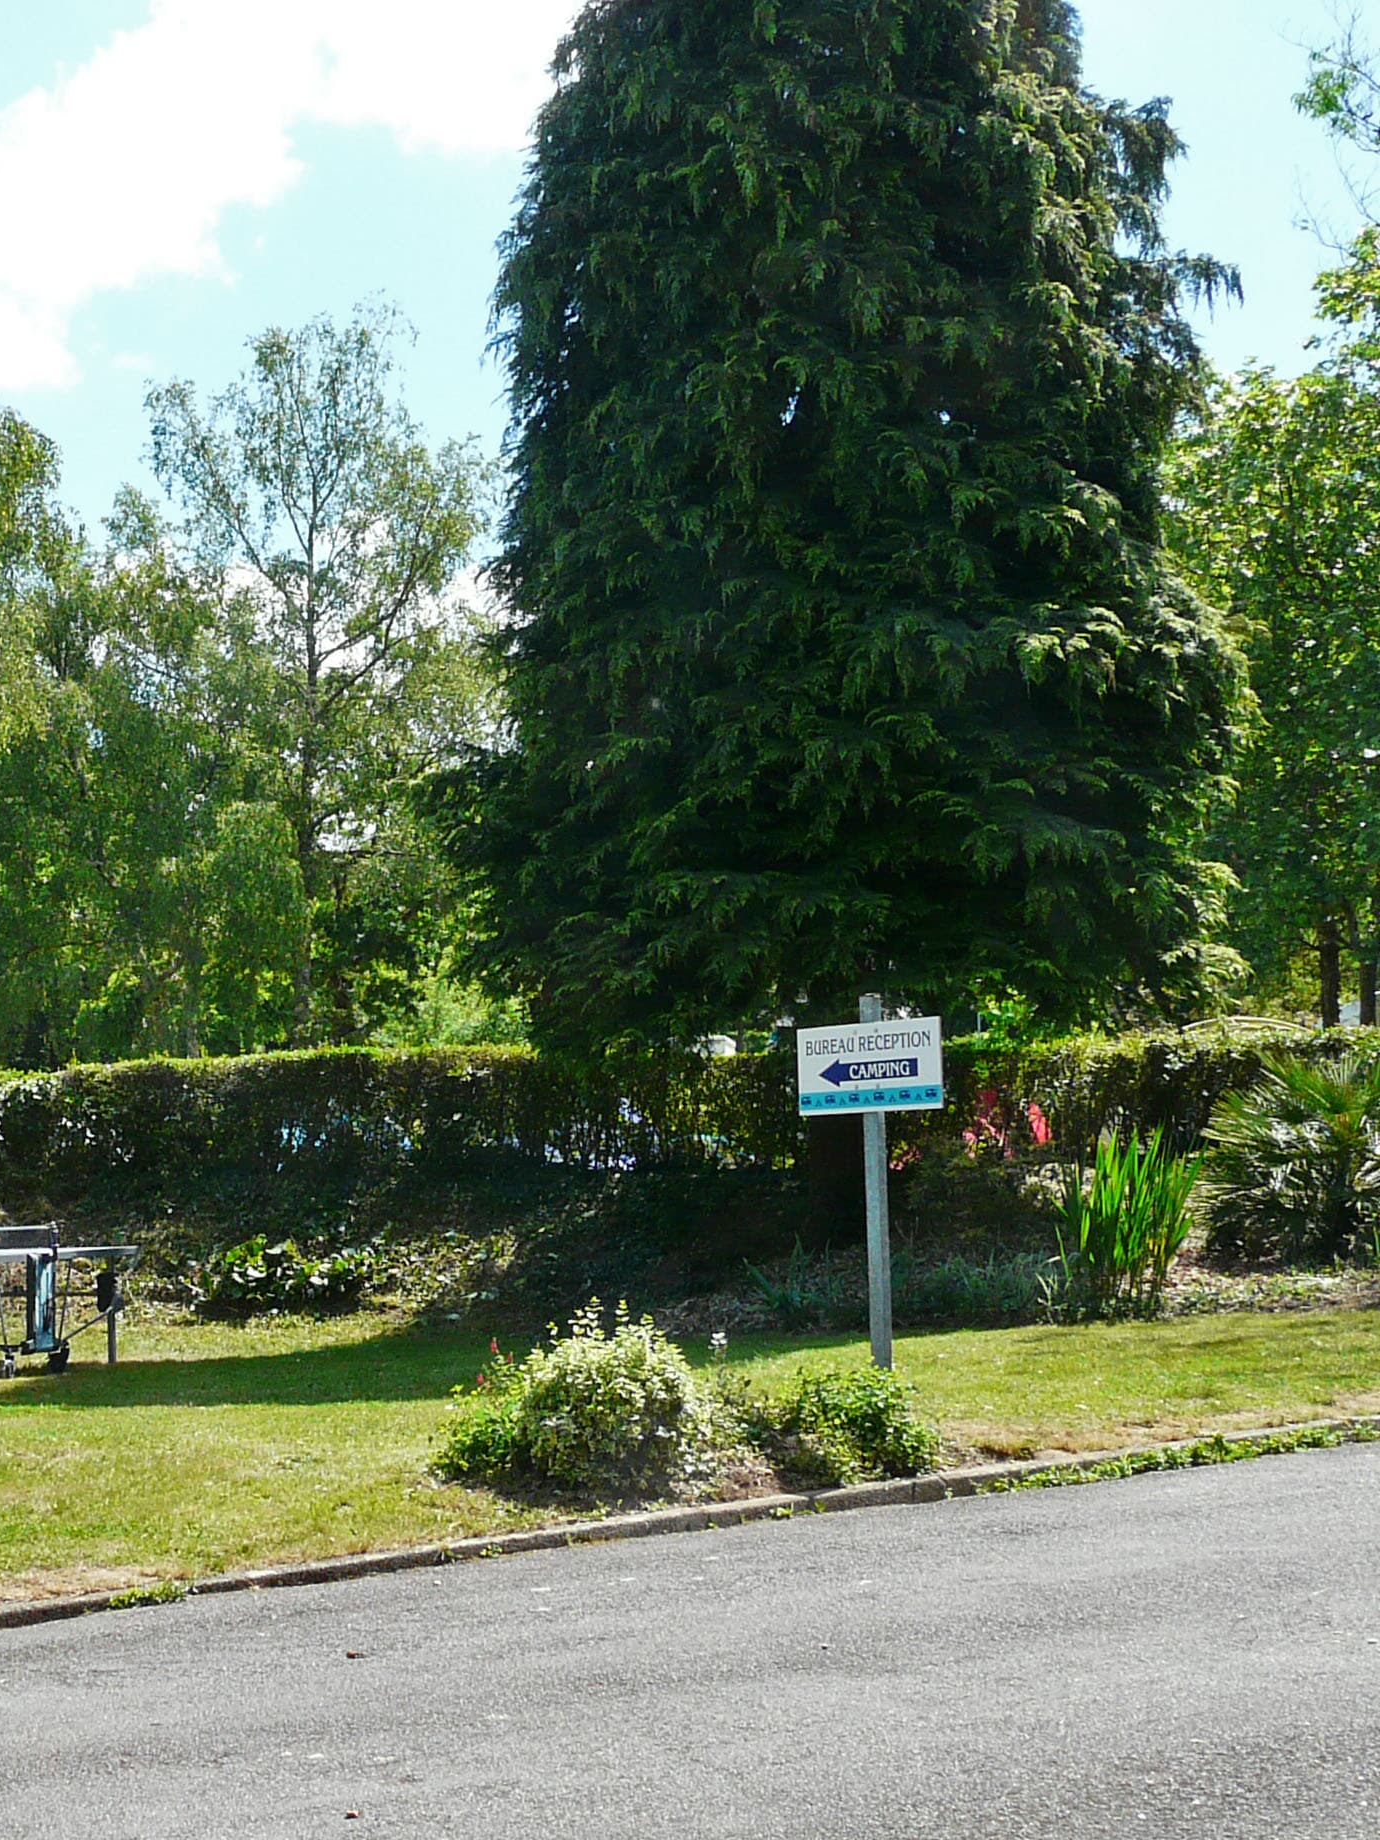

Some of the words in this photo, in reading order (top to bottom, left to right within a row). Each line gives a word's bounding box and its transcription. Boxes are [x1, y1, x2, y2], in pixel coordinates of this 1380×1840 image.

[806, 1037, 854, 1056] BUREAU
[858, 1031, 931, 1052] RECEPTION
[849, 1061, 910, 1079] CAMPING
